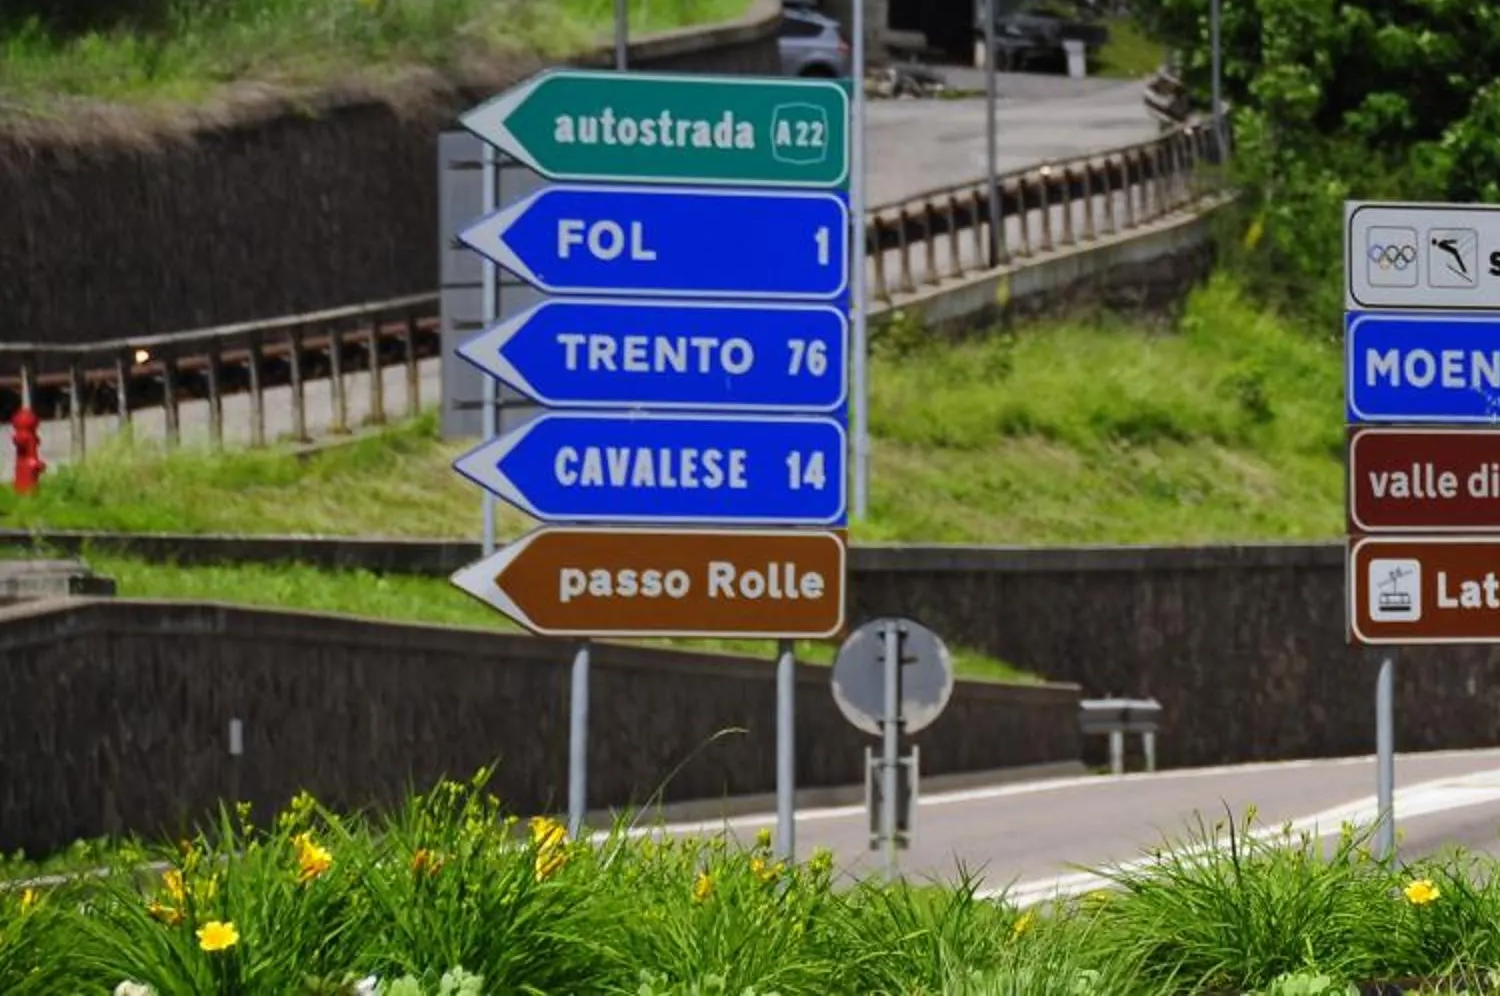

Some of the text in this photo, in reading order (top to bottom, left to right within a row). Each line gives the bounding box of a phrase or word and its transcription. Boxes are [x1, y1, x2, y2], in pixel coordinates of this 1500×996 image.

[555, 108, 755, 149] autostrada
[558, 220, 830, 265] FOL 1
[557, 333, 826, 377] TRENTO 76
[555, 448, 826, 490] CAVALESE 14
[1369, 463, 1459, 498] valle
[1467, 463, 1500, 498] di
[559, 562, 825, 601] passo Rolle
